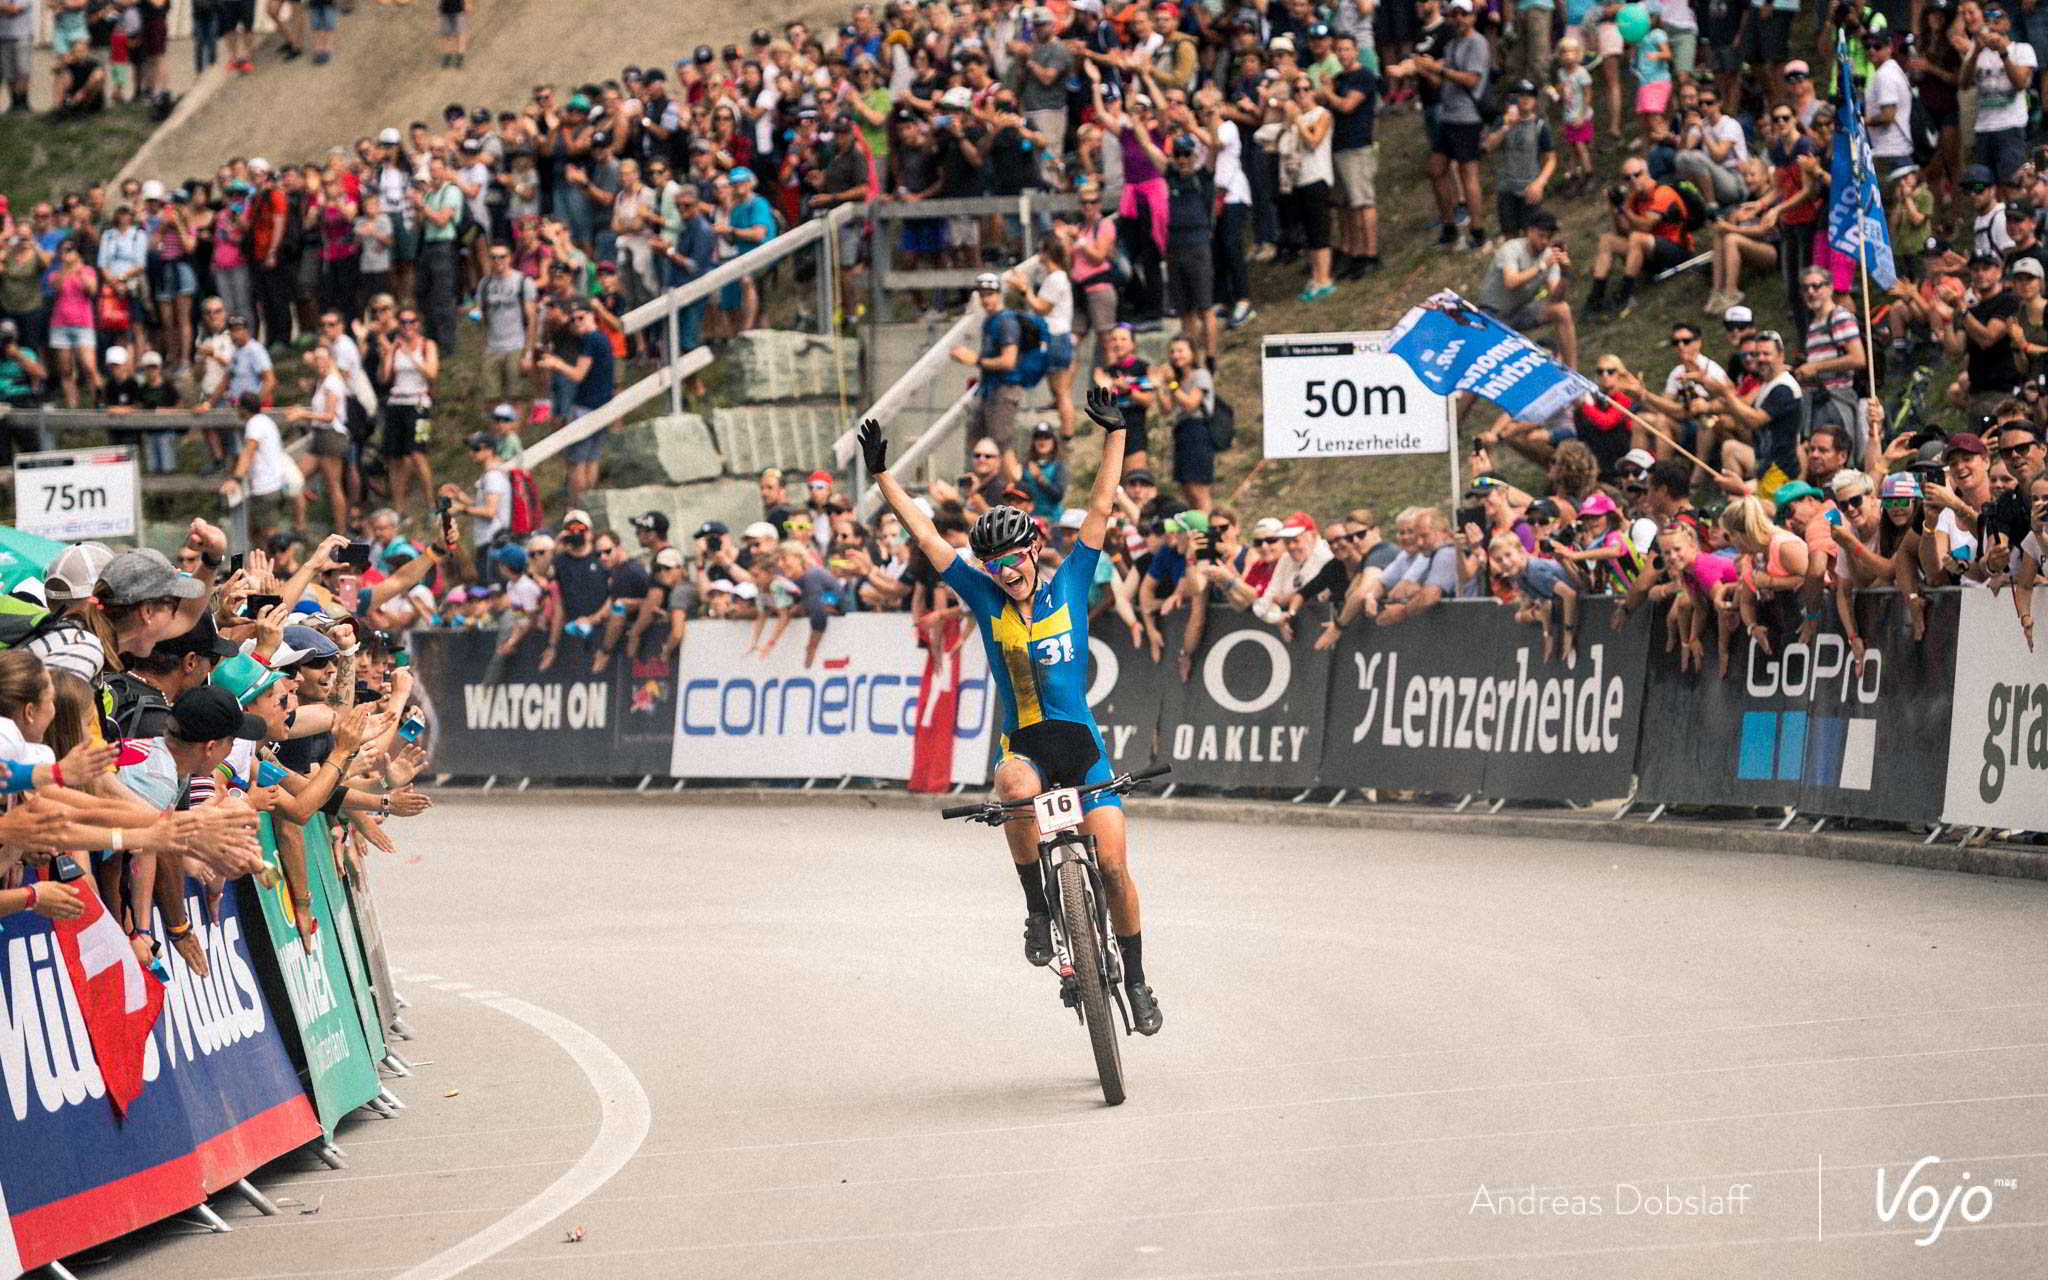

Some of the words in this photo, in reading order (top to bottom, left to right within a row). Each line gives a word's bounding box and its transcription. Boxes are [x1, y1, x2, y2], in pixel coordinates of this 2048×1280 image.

[1304, 379, 1406, 418] 50m
[1316, 433, 1422, 452] Lenzerheide
[42, 484, 106, 512] 75m
[1746, 632, 1882, 704] GoPro
[464, 683, 562, 730] WATCH
[567, 681, 608, 730] ON
[1381, 643, 1625, 754] Lenzerheide
[1173, 724, 1306, 763] OAKLEY
[1042, 794, 1072, 816] 16
